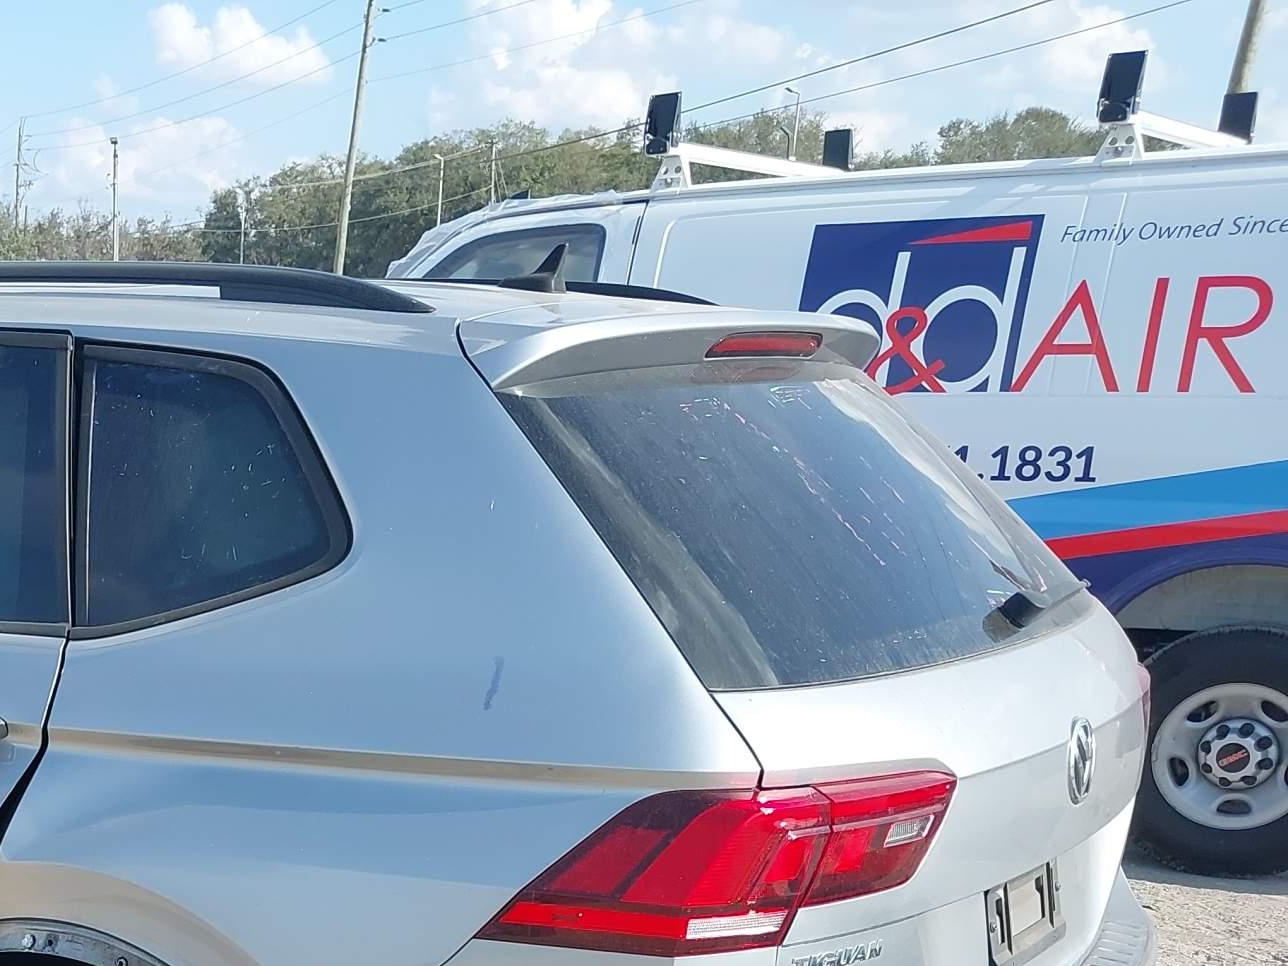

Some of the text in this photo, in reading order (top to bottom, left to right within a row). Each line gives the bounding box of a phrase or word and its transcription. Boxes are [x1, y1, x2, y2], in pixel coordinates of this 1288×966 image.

[1061, 215, 1288, 246] Family Owned Since
[1011, 276, 1275, 393] AIR
